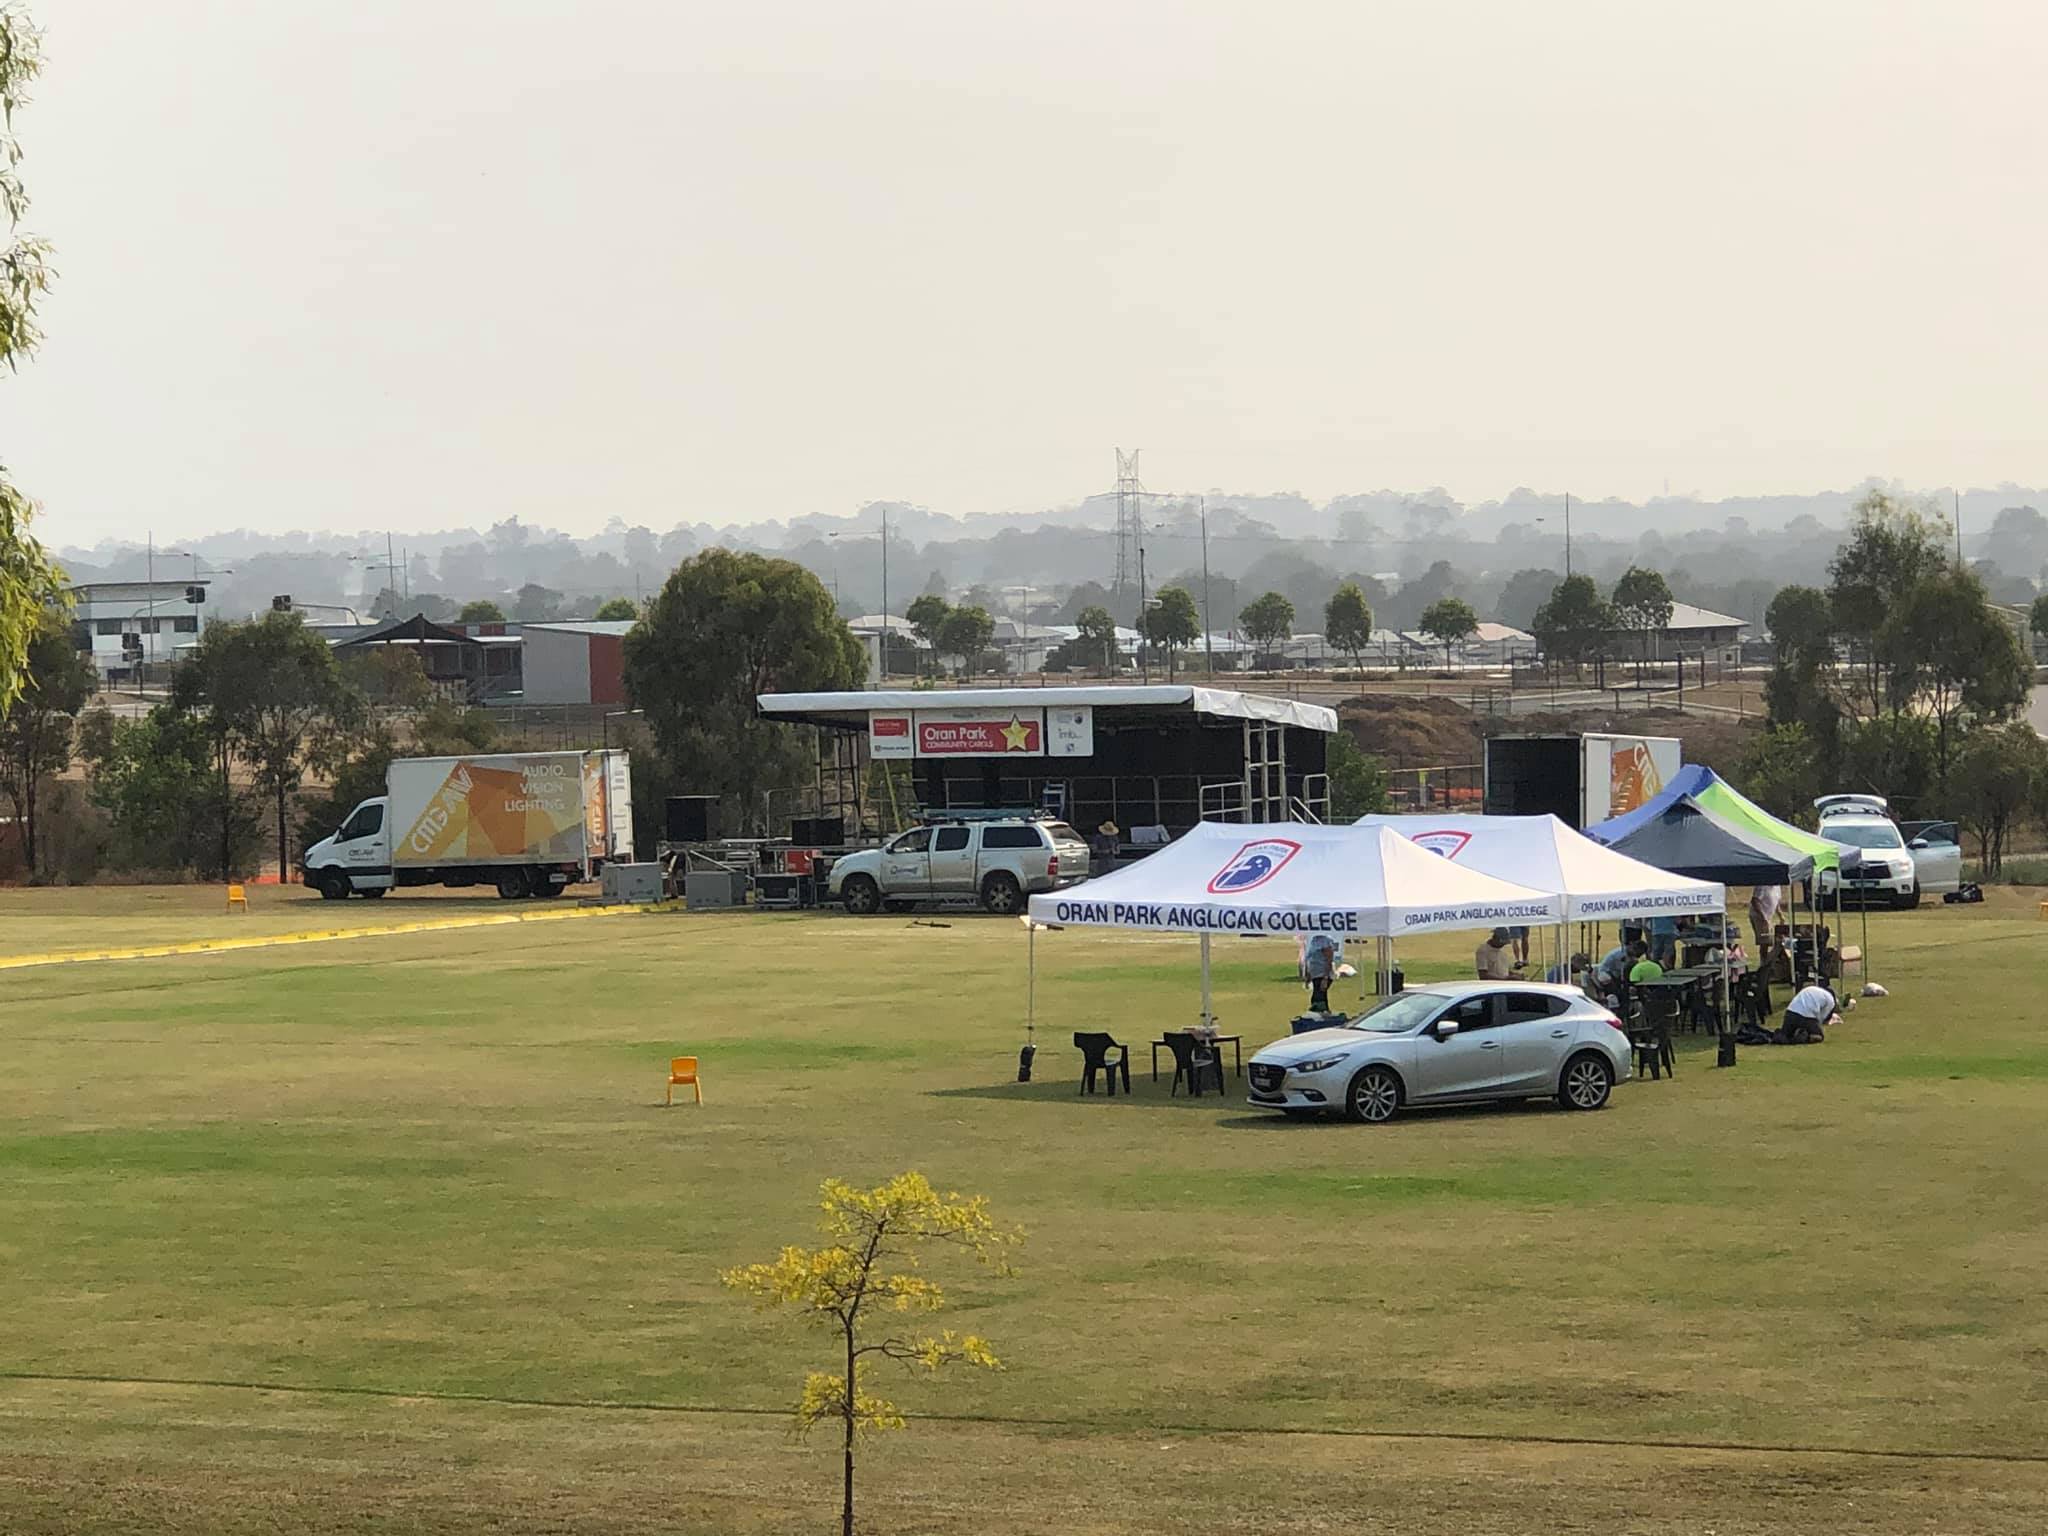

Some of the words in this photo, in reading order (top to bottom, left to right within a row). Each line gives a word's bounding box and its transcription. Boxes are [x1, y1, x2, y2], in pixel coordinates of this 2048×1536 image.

[924, 727, 957, 741] Oran
[959, 726, 987, 740] Park
[1581, 901, 1606, 913] ORAN
[1607, 899, 1630, 911] PARK
[1631, 896, 1675, 908] ANGLICAN
[1676, 894, 1713, 906] COLLEGE
[1057, 902, 1108, 923] ORAN
[1114, 904, 1162, 926] PARK
[1167, 907, 1264, 930] ANGLICAN
[1267, 911, 1358, 932] COLLEGE
[1404, 914, 1431, 926] ORAN
[1433, 910, 1458, 922] PARK
[1460, 906, 1505, 920] ANGLICAN
[1507, 904, 1549, 917] COLLEGE
